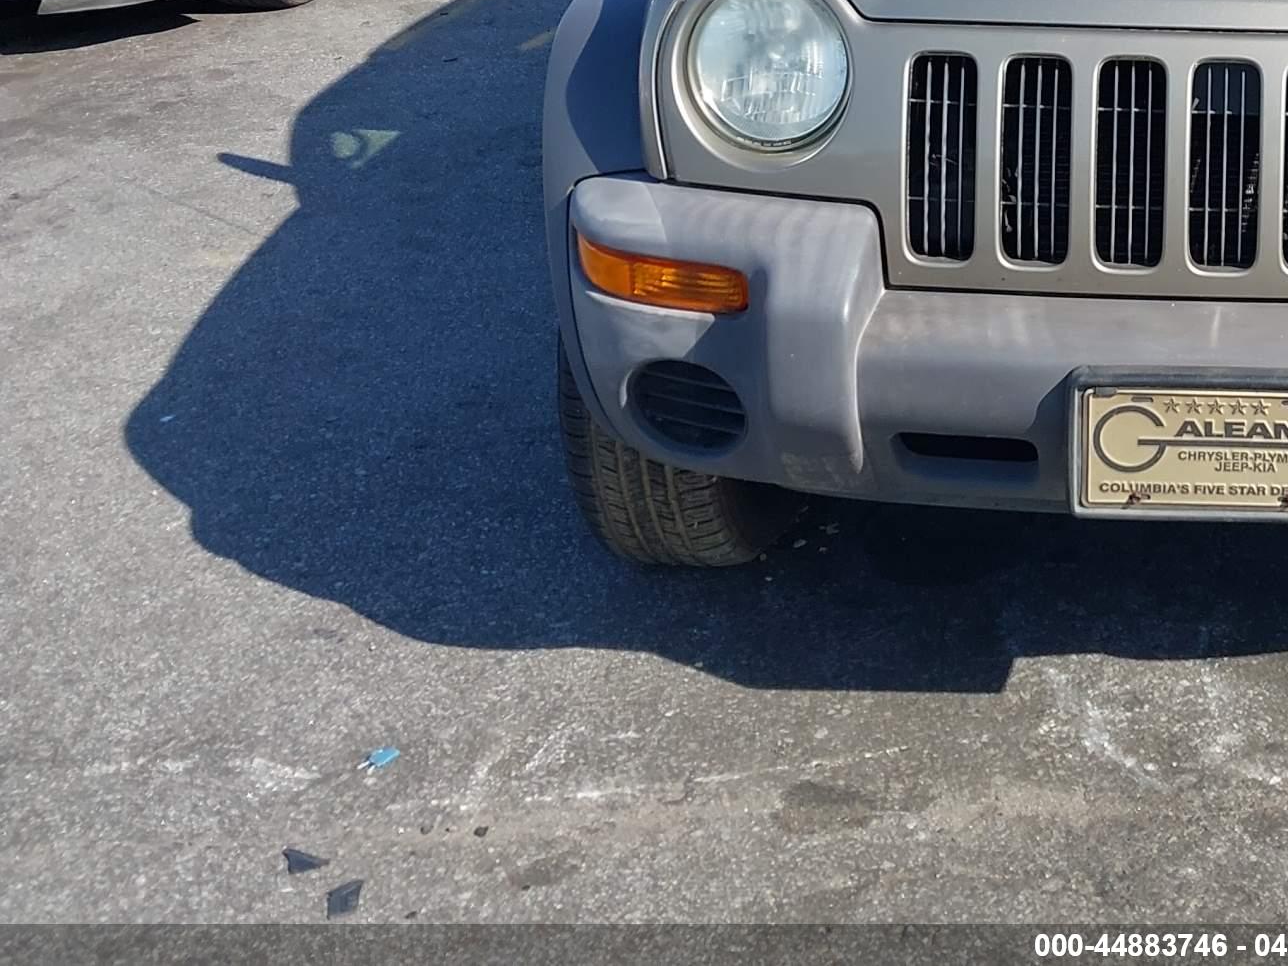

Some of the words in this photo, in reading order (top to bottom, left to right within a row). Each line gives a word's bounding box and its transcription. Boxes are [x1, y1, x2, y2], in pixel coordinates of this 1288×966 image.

[1214, 462, 1276, 473] JEEP-KIA
[1100, 482, 1190, 495] COLUMBIA'S
[1194, 485, 1225, 495] FIVE
[1229, 486, 1266, 496] STAR
